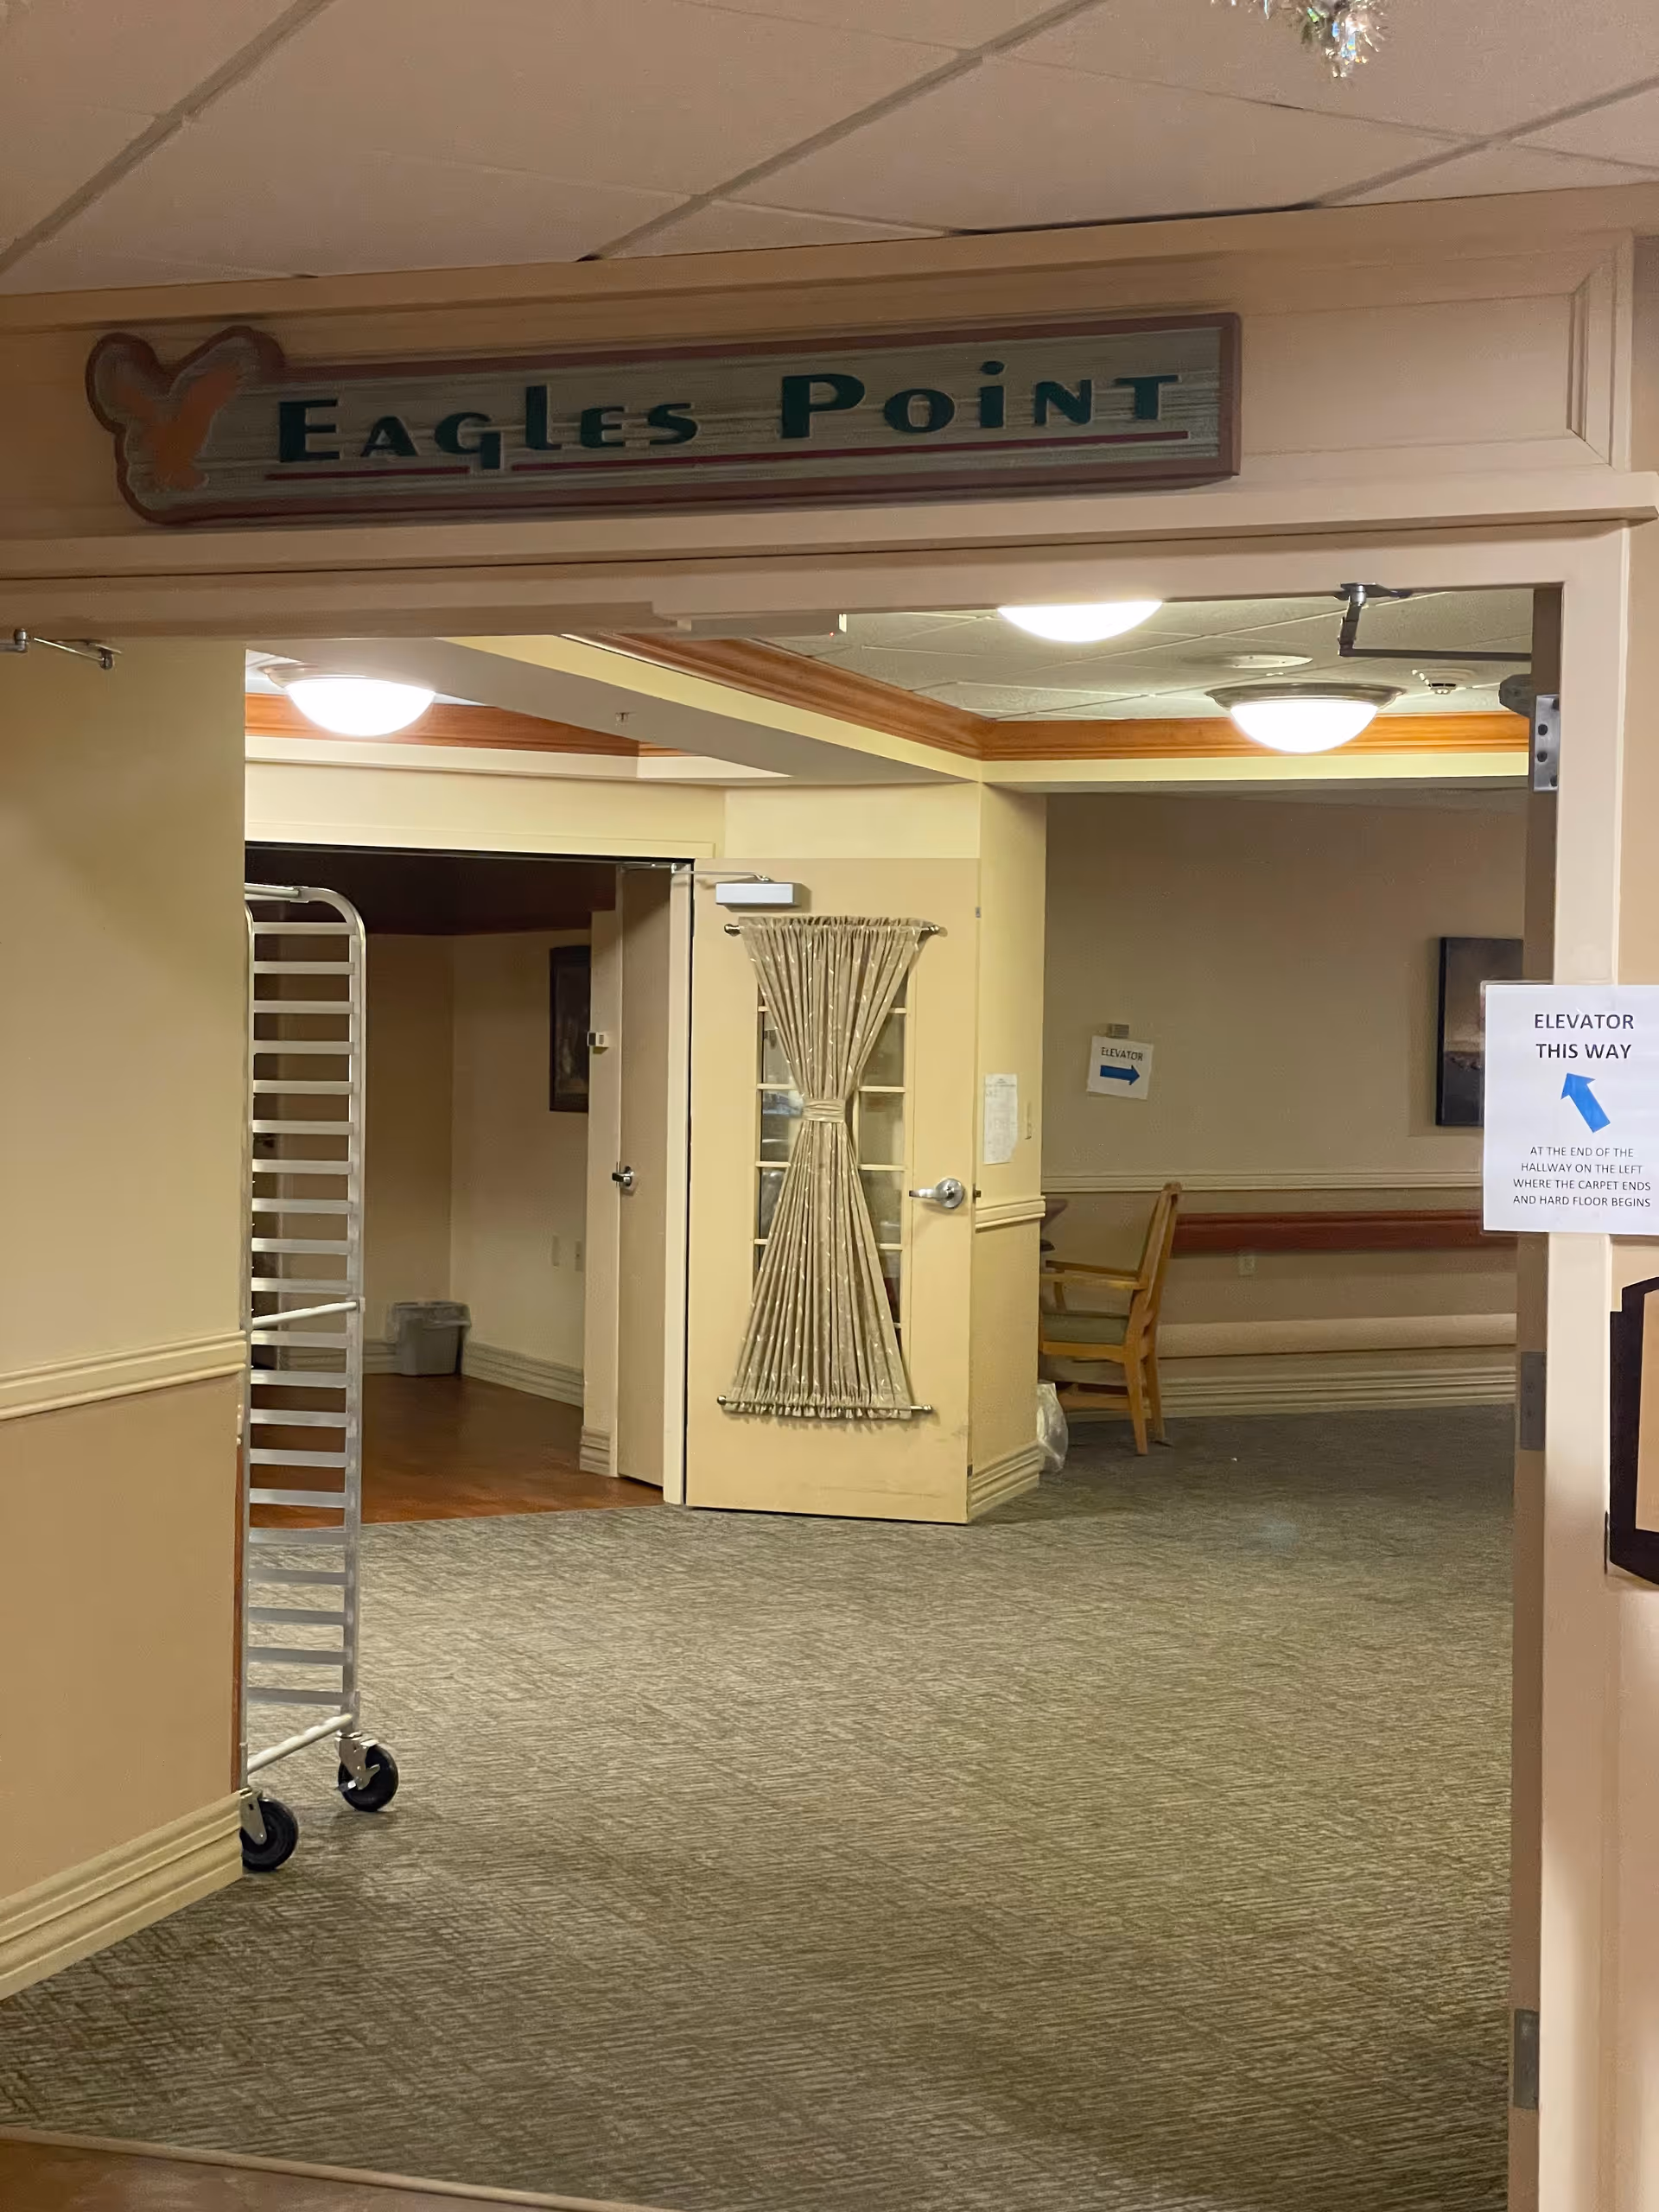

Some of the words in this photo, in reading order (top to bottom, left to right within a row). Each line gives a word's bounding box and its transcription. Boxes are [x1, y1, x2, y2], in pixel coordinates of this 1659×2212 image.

[1535, 1014, 1634, 1030] ELEVATOR
[1101, 1047, 1143, 1061] ELEVATOR
[1535, 1043, 1579, 1059] THIS
[1584, 1043, 1632, 1059] WAY
[1529, 1146, 1543, 1156] AT
[1546, 1147, 1567, 1156] THE
[1570, 1147, 1593, 1157] END
[1595, 1147, 1611, 1157] OF
[1612, 1147, 1634, 1158] THE
[1521, 1162, 1573, 1173] HALLWAY
[1574, 1163, 1592, 1173] ON
[1595, 1164, 1615, 1174] THE
[1618, 1165, 1643, 1174] LEFT
[1512, 1179, 1552, 1189] WHERE
[1554, 1179, 1575, 1189] THE
[1578, 1179, 1618, 1191] CARPET
[1622, 1181, 1651, 1192] ENDS
[1512, 1195, 1536, 1205] AND
[1539, 1195, 1570, 1205] HARD
[1573, 1196, 1608, 1206] FLOOR
[1611, 1197, 1651, 1208] BEGINS
